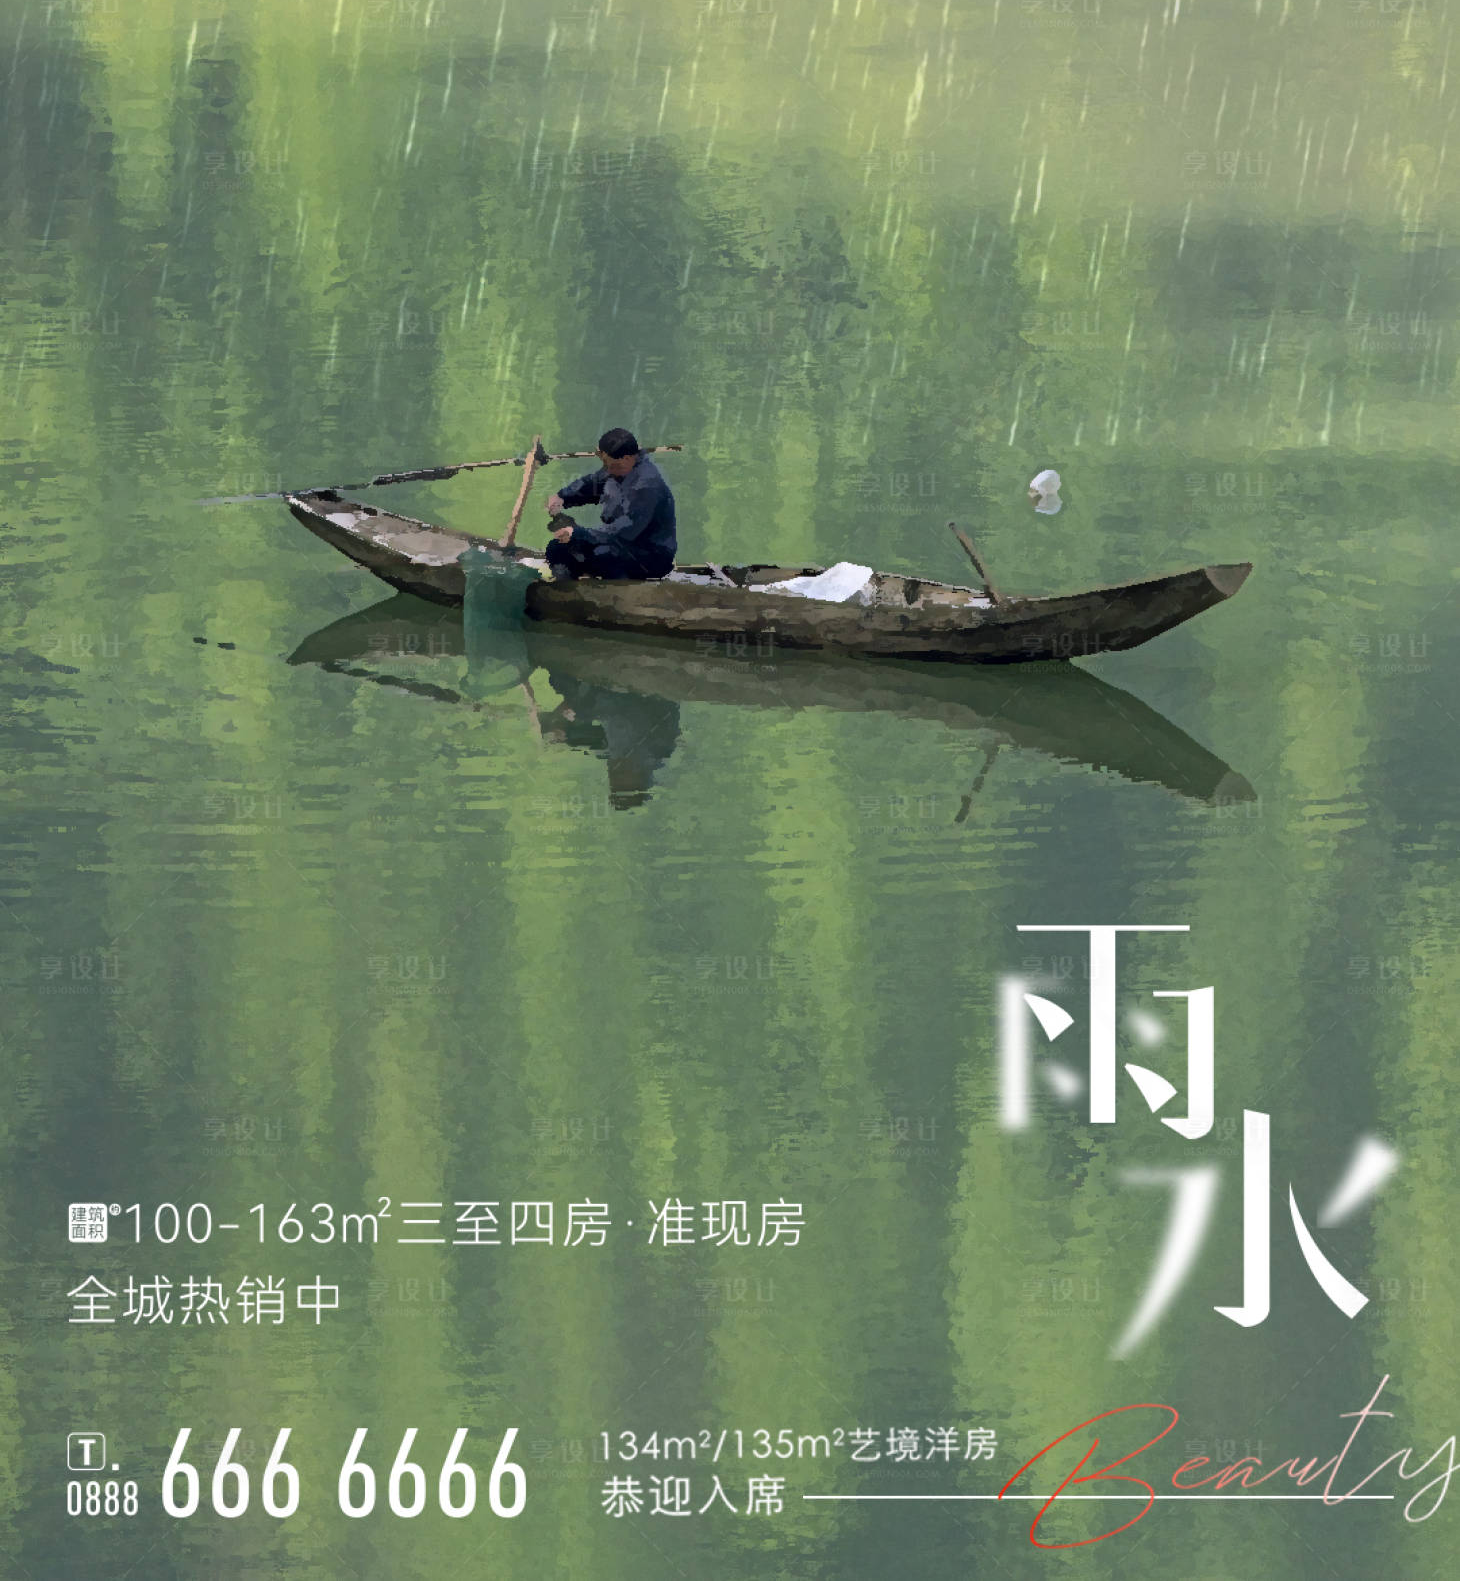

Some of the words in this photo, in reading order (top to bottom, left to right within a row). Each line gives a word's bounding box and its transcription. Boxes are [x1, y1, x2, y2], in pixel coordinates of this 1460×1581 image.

[997, 923, 1402, 1360] 雨水
[72, 1206, 105, 1222] 建筑
[72, 1223, 105, 1239] 面积
[67, 1275, 339, 1325] 全城热销中
[162, 1427, 300, 1518] 666
[338, 1427, 527, 1518] 6666
[998, 1373, 1460, 1549] Beauty
[67, 1480, 139, 1516] 0888
[601, 1473, 785, 1518] 恭迎入席
